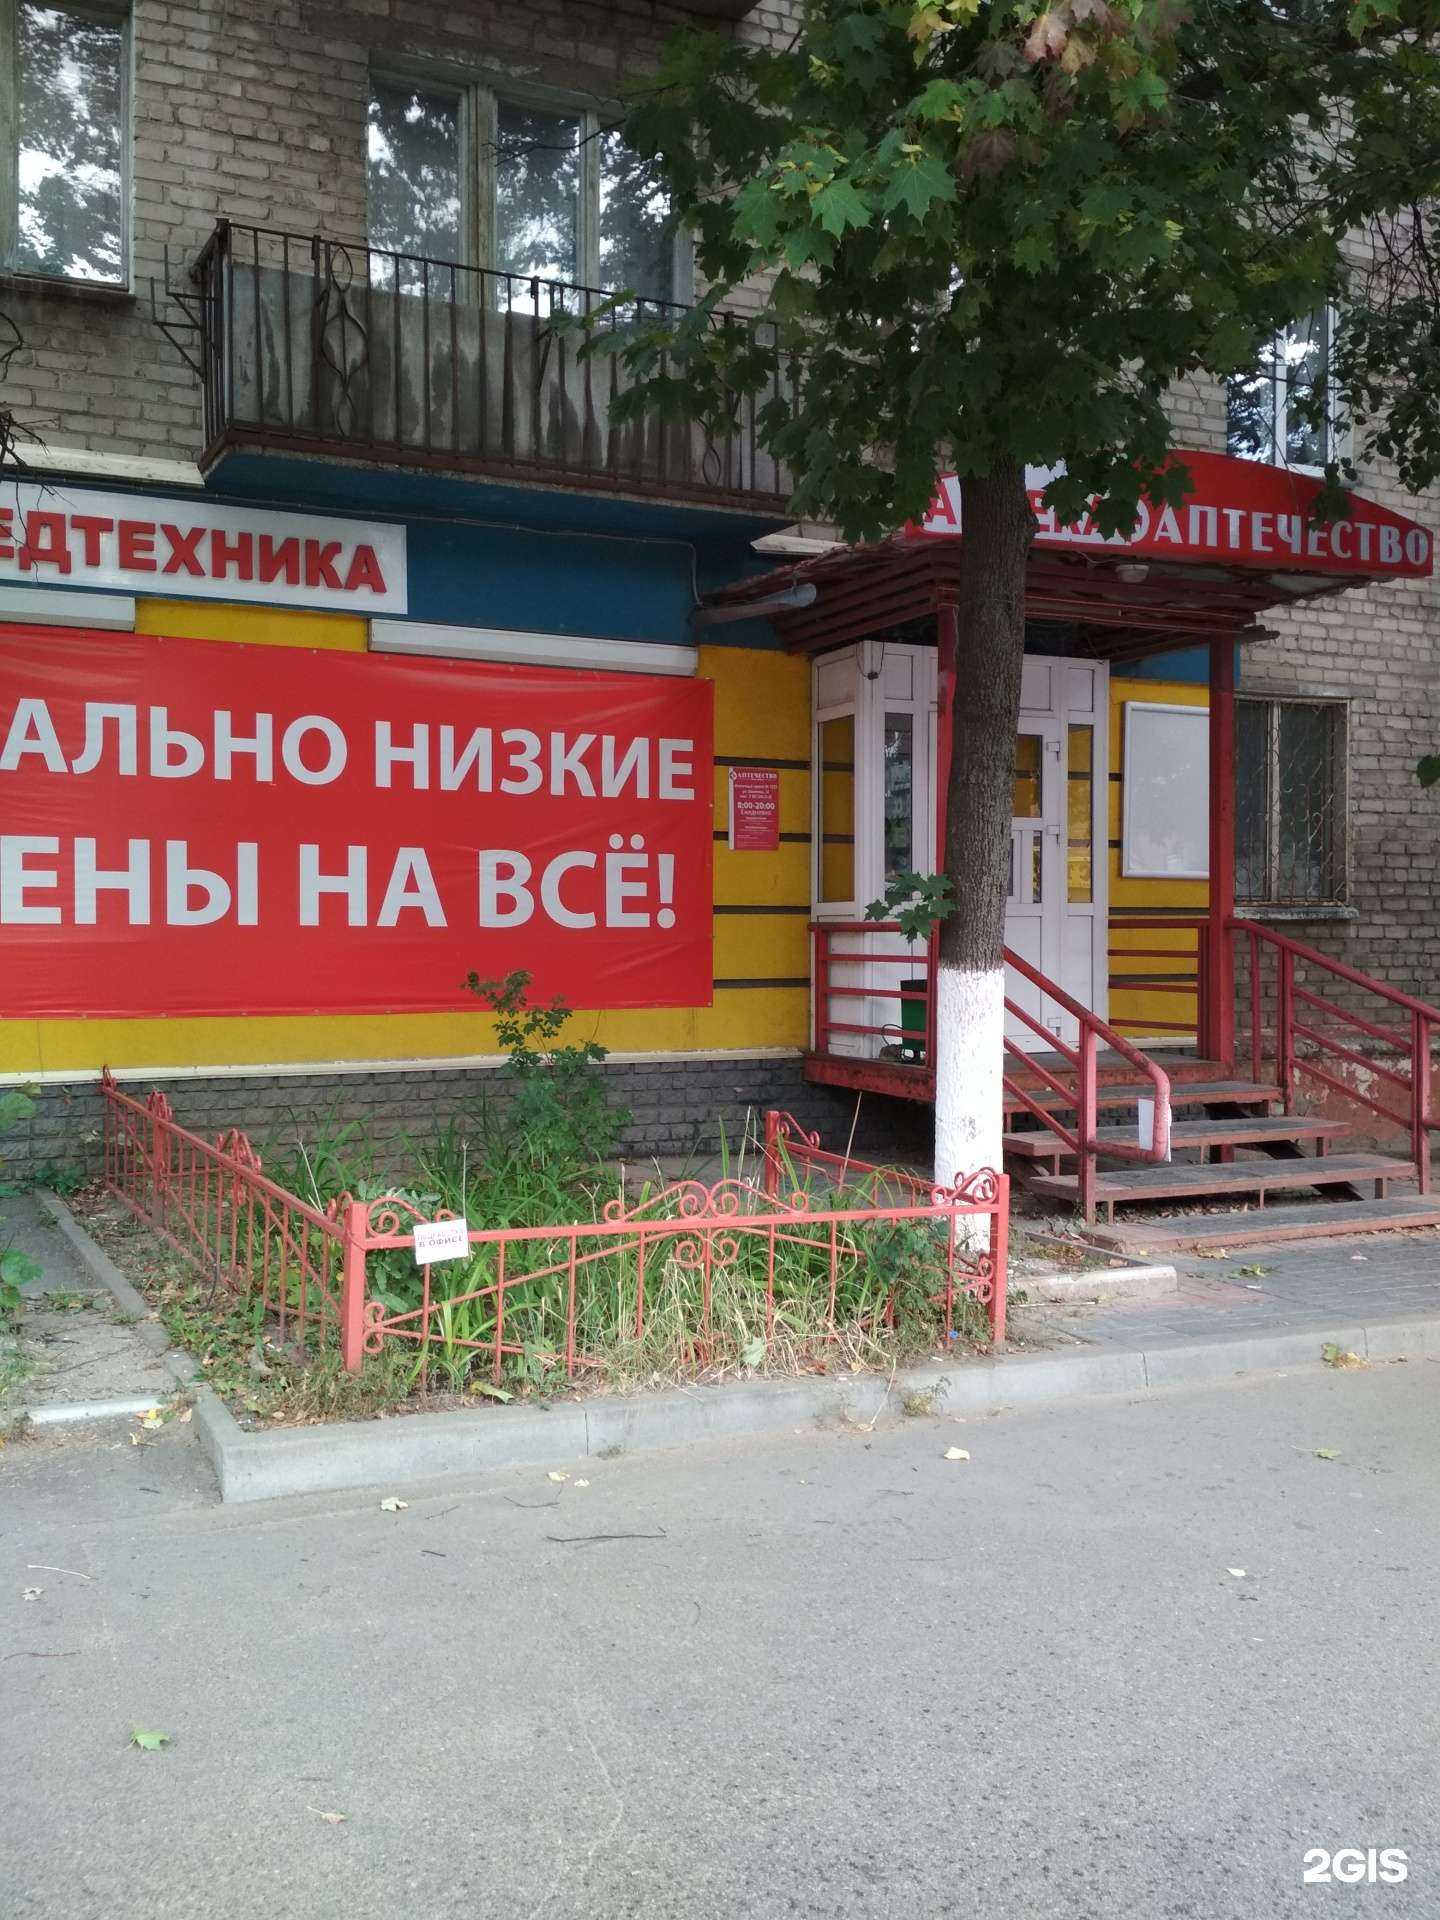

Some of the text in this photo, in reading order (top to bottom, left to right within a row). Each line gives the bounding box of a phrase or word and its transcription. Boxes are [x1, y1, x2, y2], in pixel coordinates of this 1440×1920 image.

[1154, 502, 1429, 566] АПТЕЧЕСТВО
[0, 698, 695, 801] АЛЬНО НИЗКИЕ
[0, 834, 676, 929] ЕНЫ НА ВСЁ!
